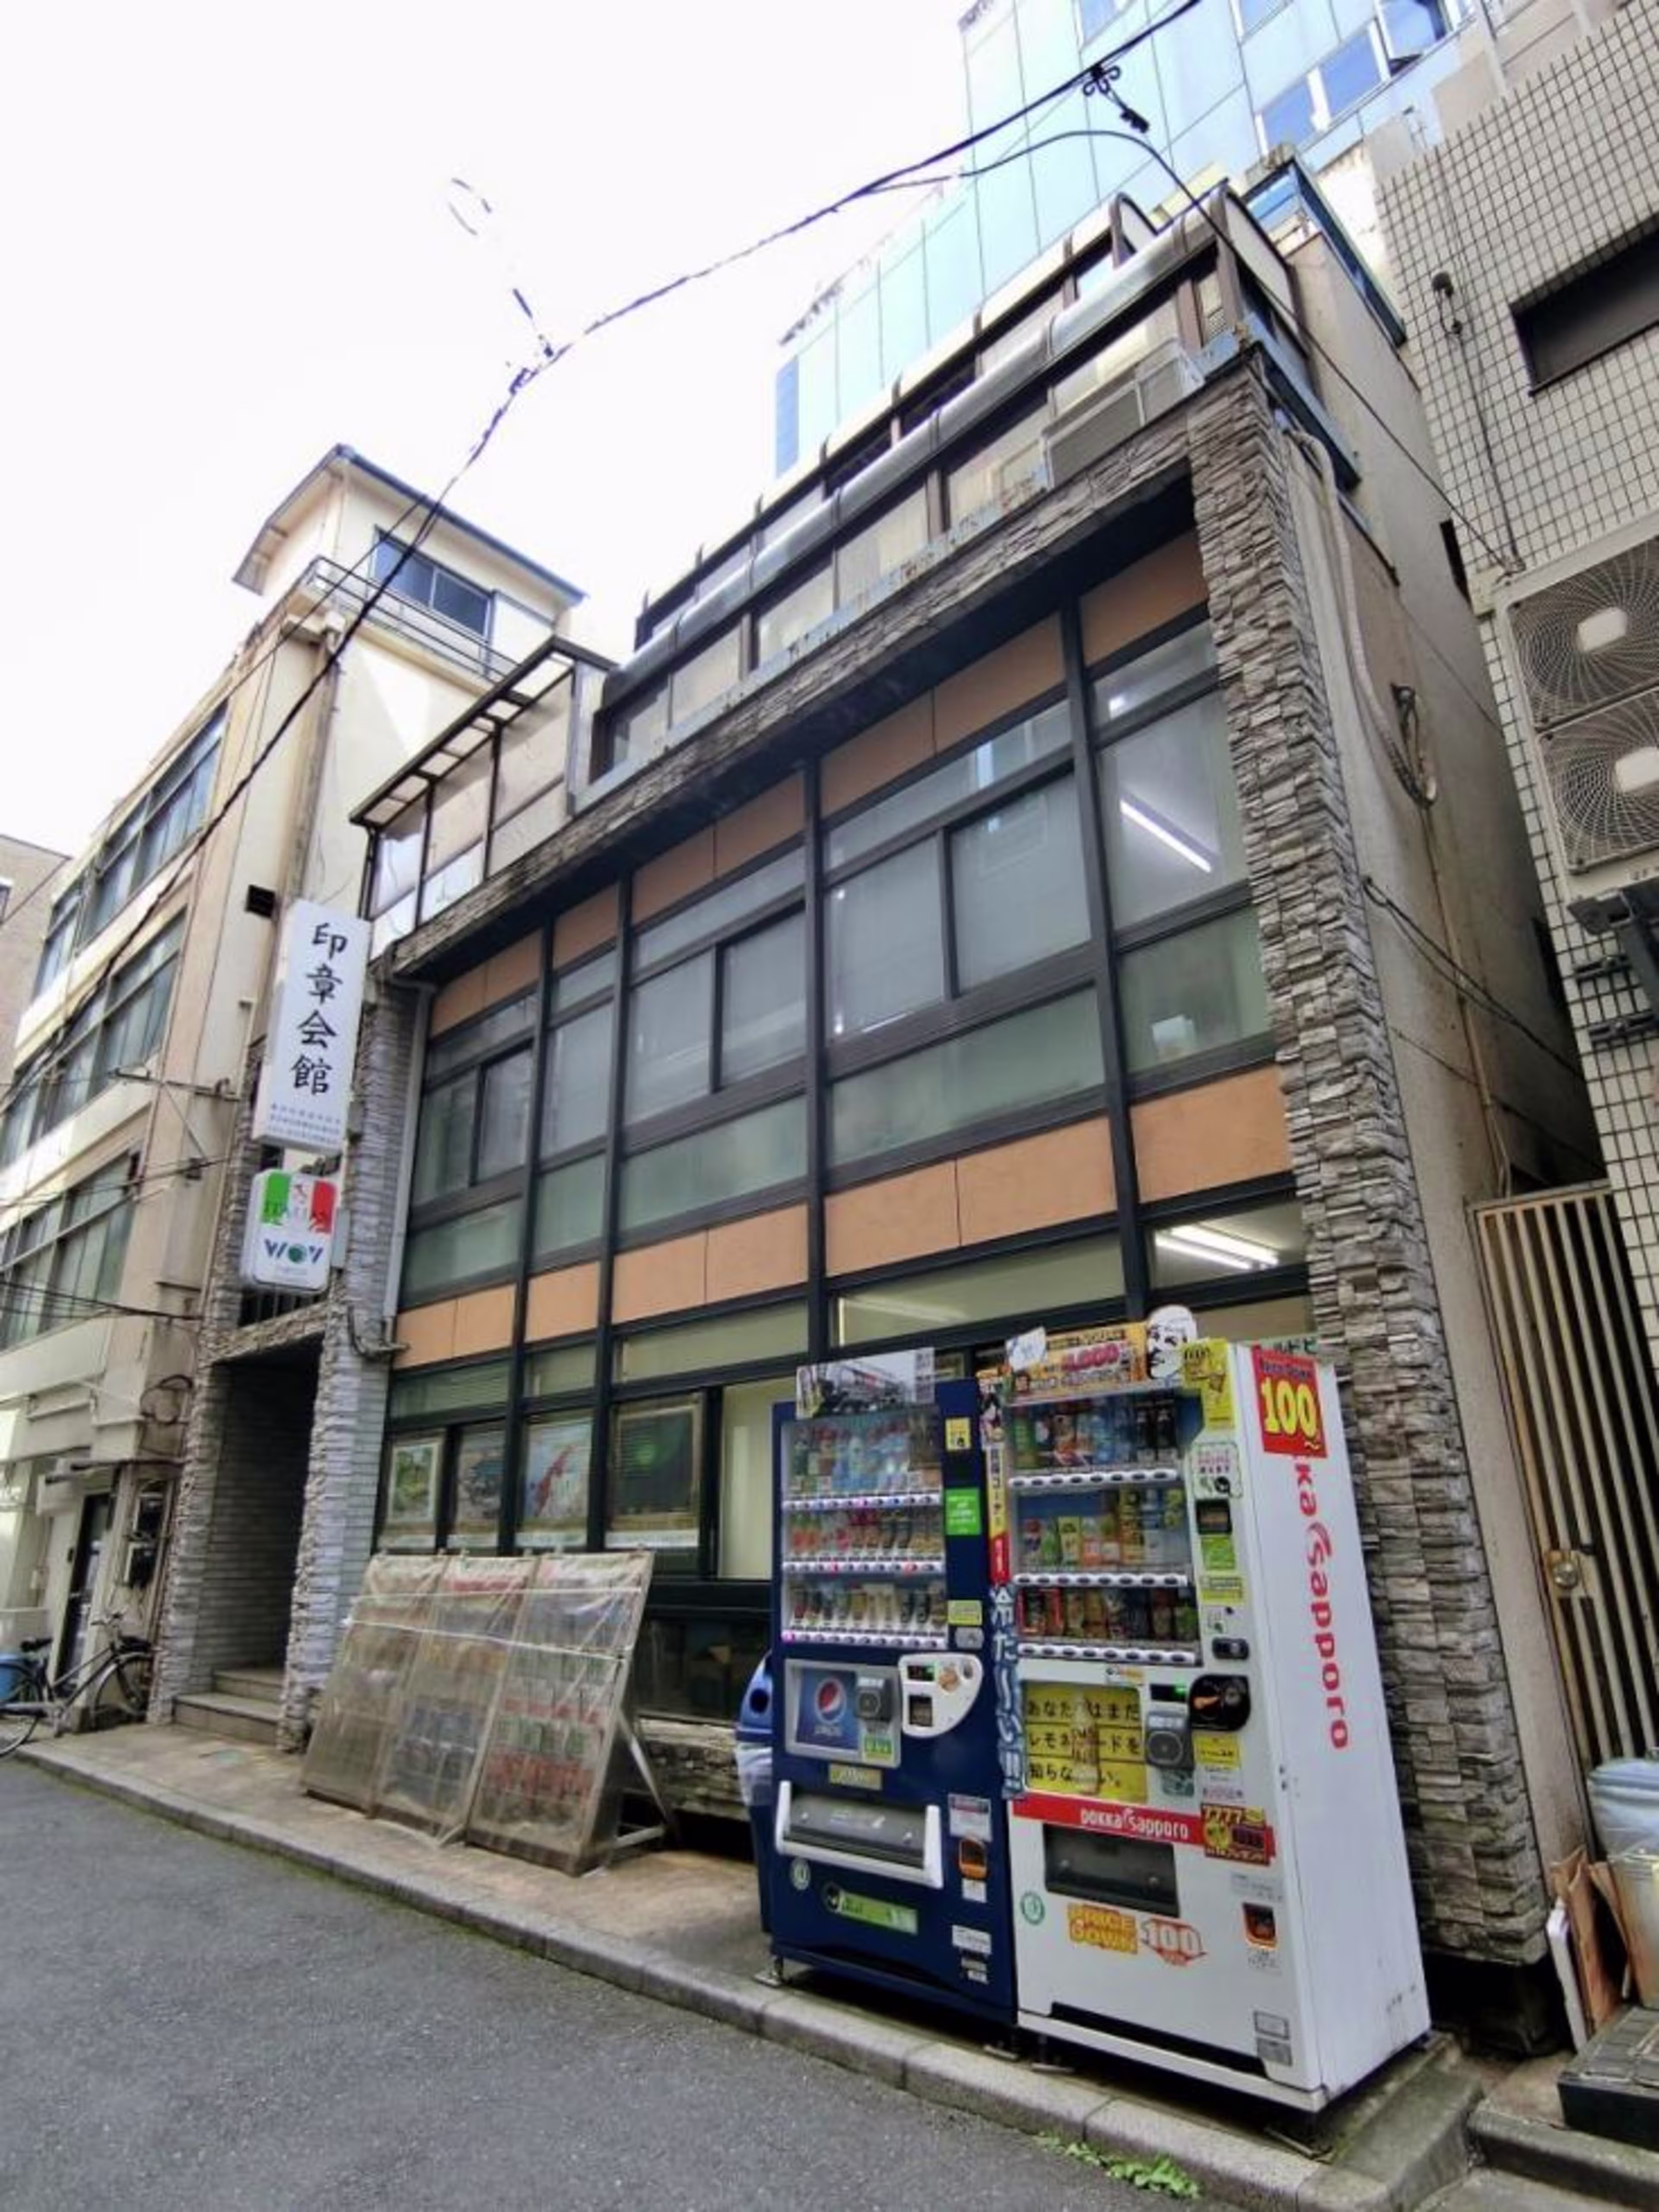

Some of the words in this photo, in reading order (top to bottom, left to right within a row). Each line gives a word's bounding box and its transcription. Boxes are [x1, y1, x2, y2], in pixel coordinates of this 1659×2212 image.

[290, 922, 348, 1096] 印章会館
[1261, 1376, 1317, 1438] 100
